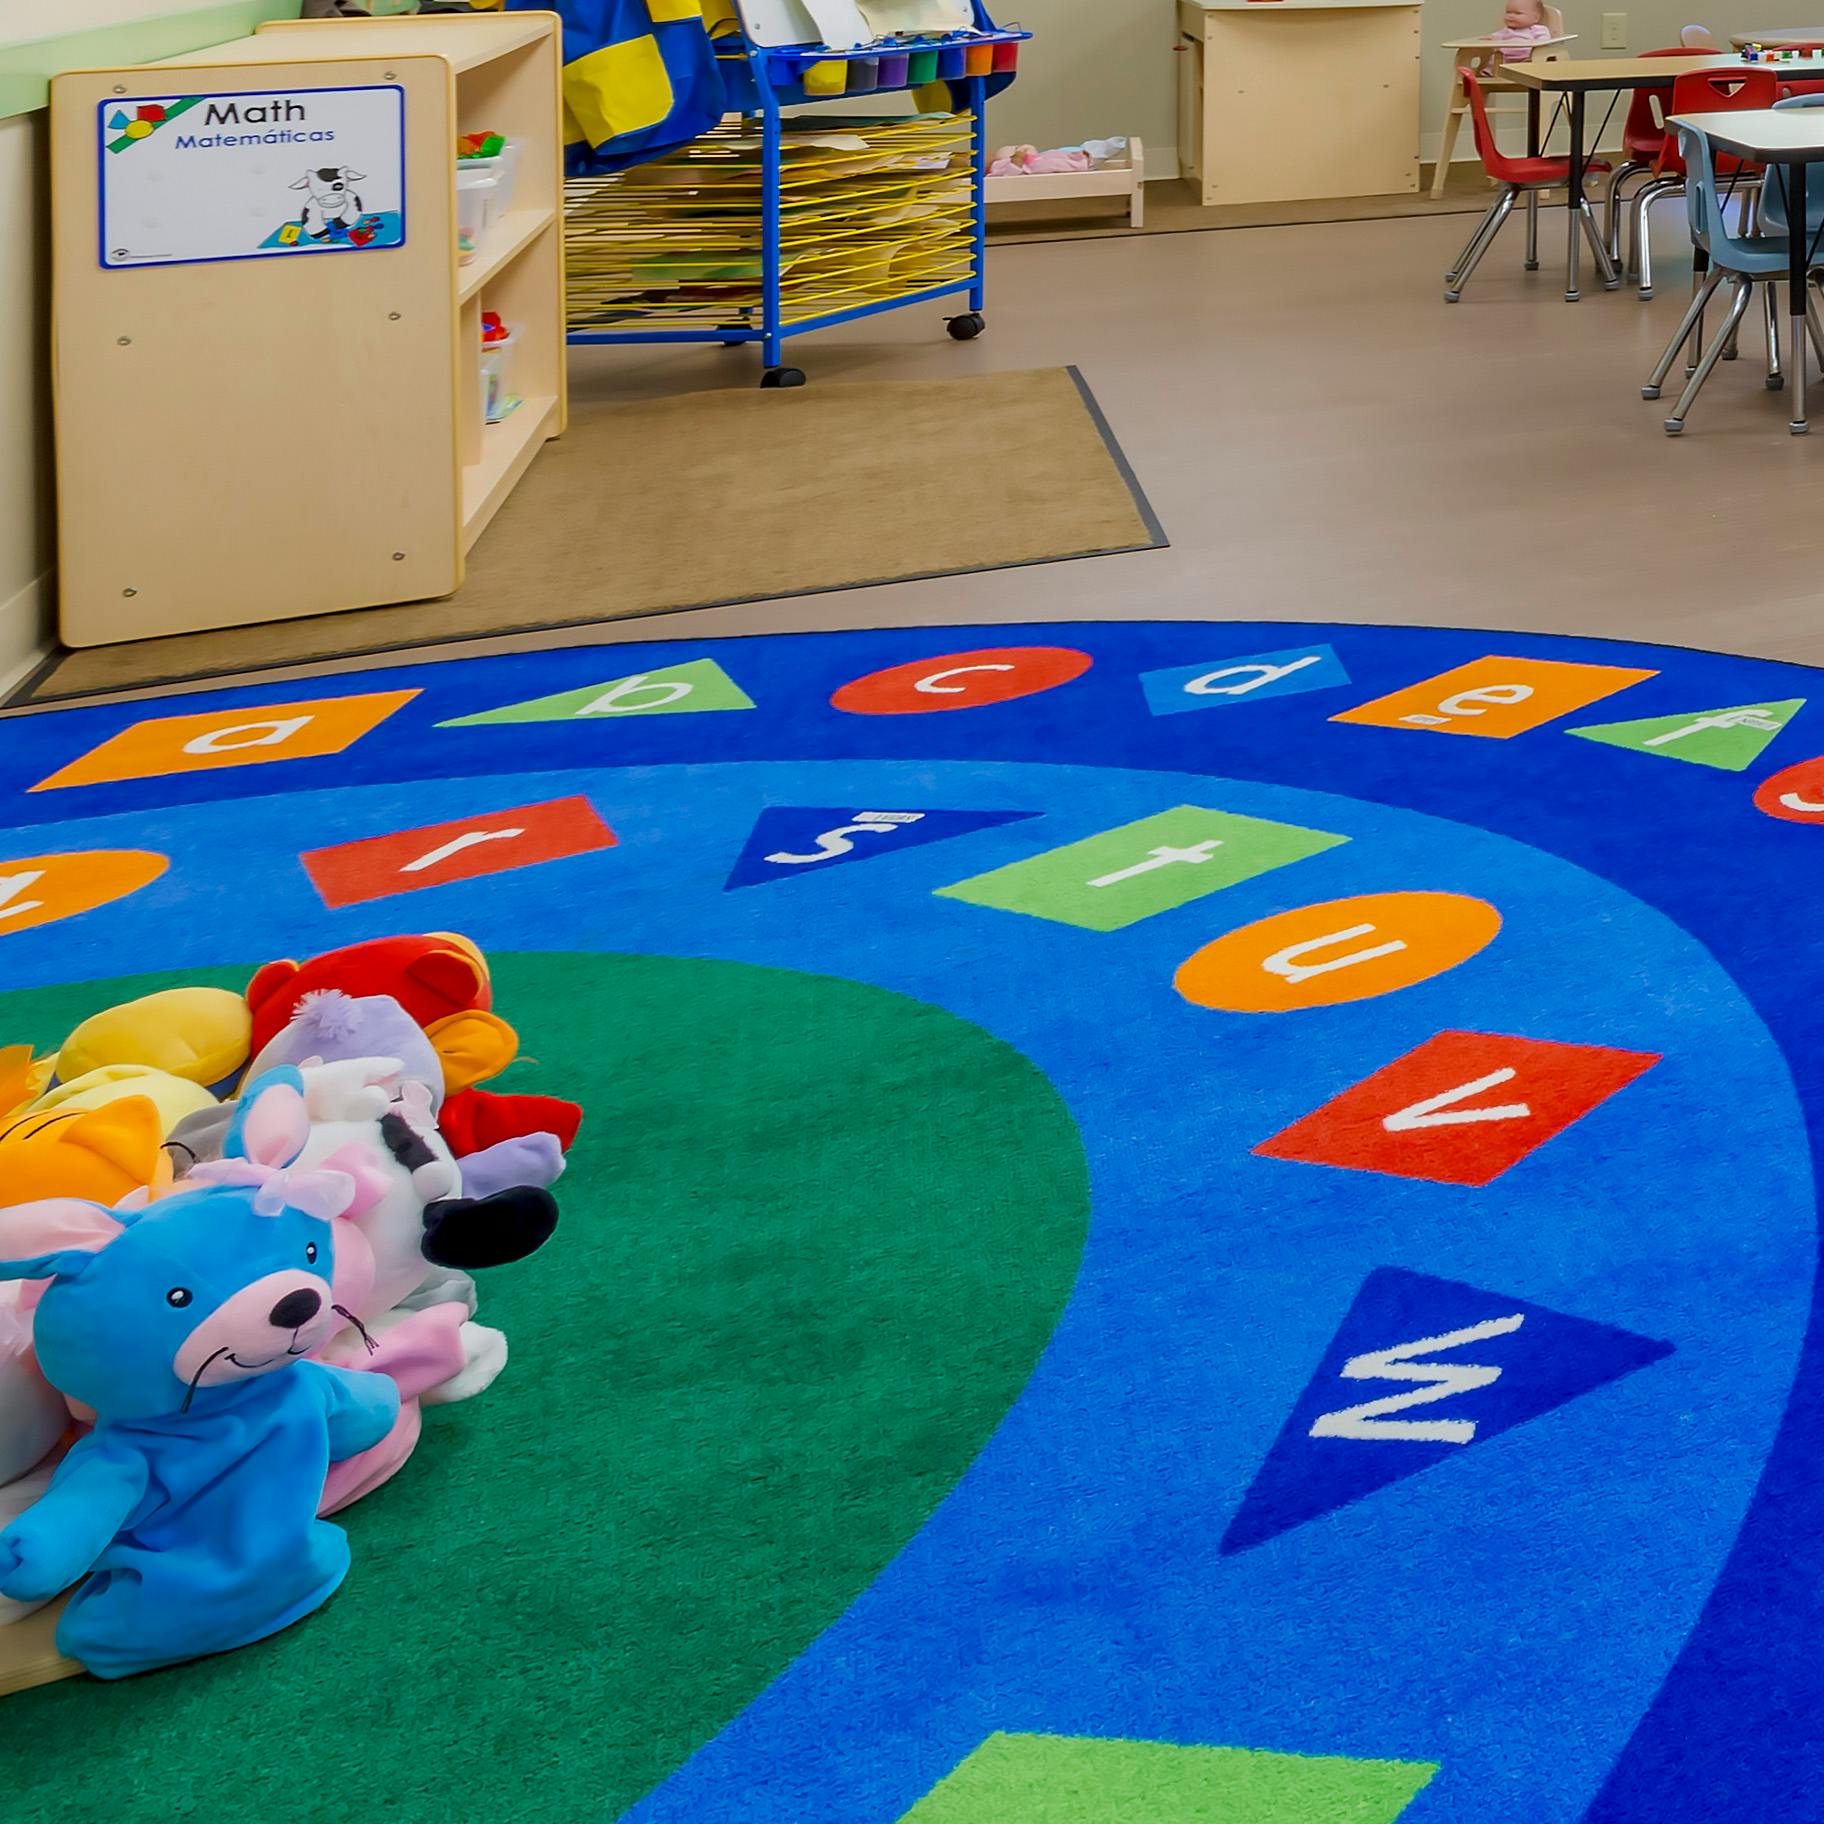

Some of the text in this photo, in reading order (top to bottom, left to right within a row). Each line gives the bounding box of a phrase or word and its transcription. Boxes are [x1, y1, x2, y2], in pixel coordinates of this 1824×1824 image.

[204, 99, 305, 126] Math
[174, 129, 335, 150] Matemáticas
[1183, 655, 1322, 695] d
[575, 676, 694, 715] b
[1437, 684, 1535, 716] e
[182, 715, 315, 755] a
[1642, 708, 1773, 746] f
[398, 828, 526, 872] r
[1086, 839, 1225, 888] t
